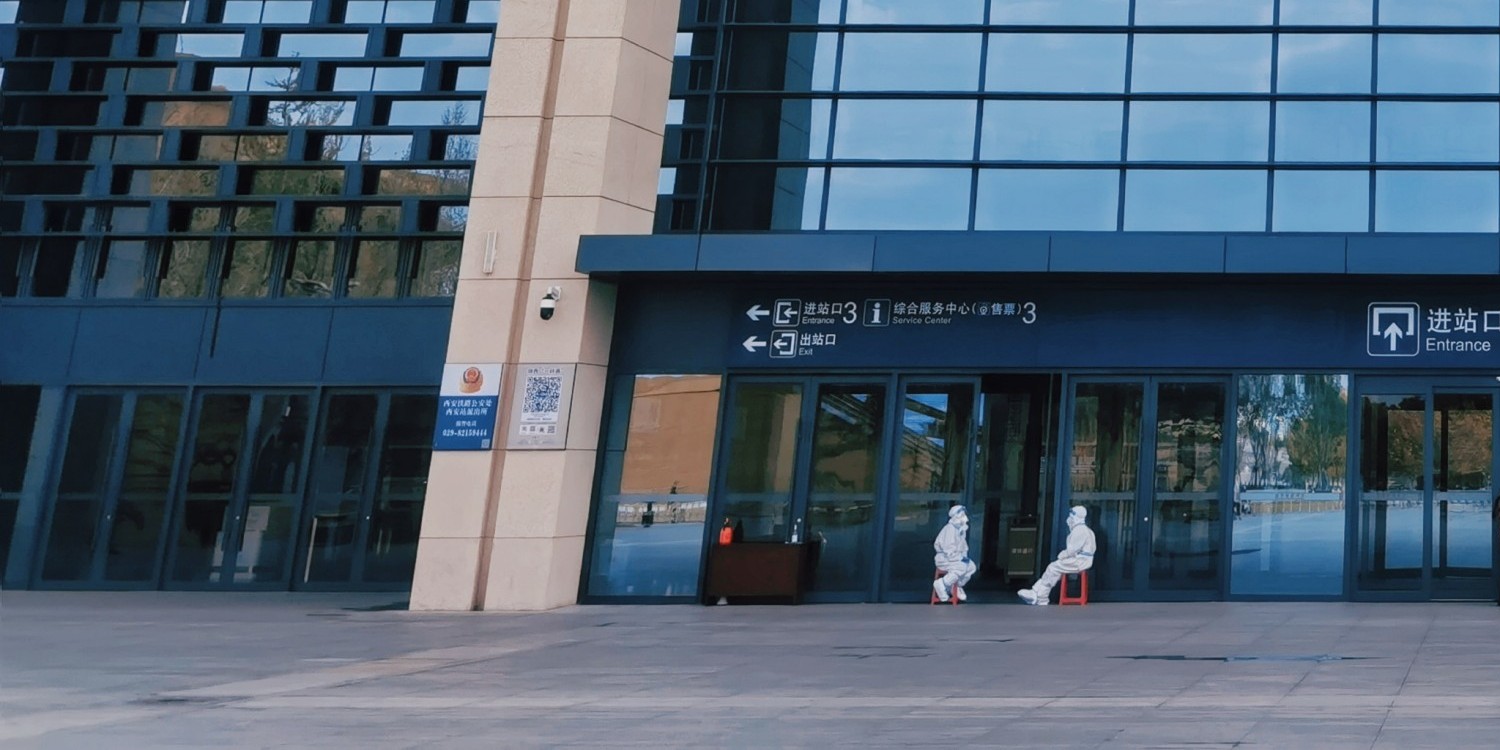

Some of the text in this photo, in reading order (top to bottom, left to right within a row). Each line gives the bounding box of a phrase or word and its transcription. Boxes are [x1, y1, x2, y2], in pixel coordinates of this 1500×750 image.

[803, 301, 857, 324] 进站口 3
[1022, 302, 1037, 324] 3
[892, 316, 952, 324] Service Center
[800, 333, 836, 346] 出站口
[1426, 338, 1491, 351] Entrance
